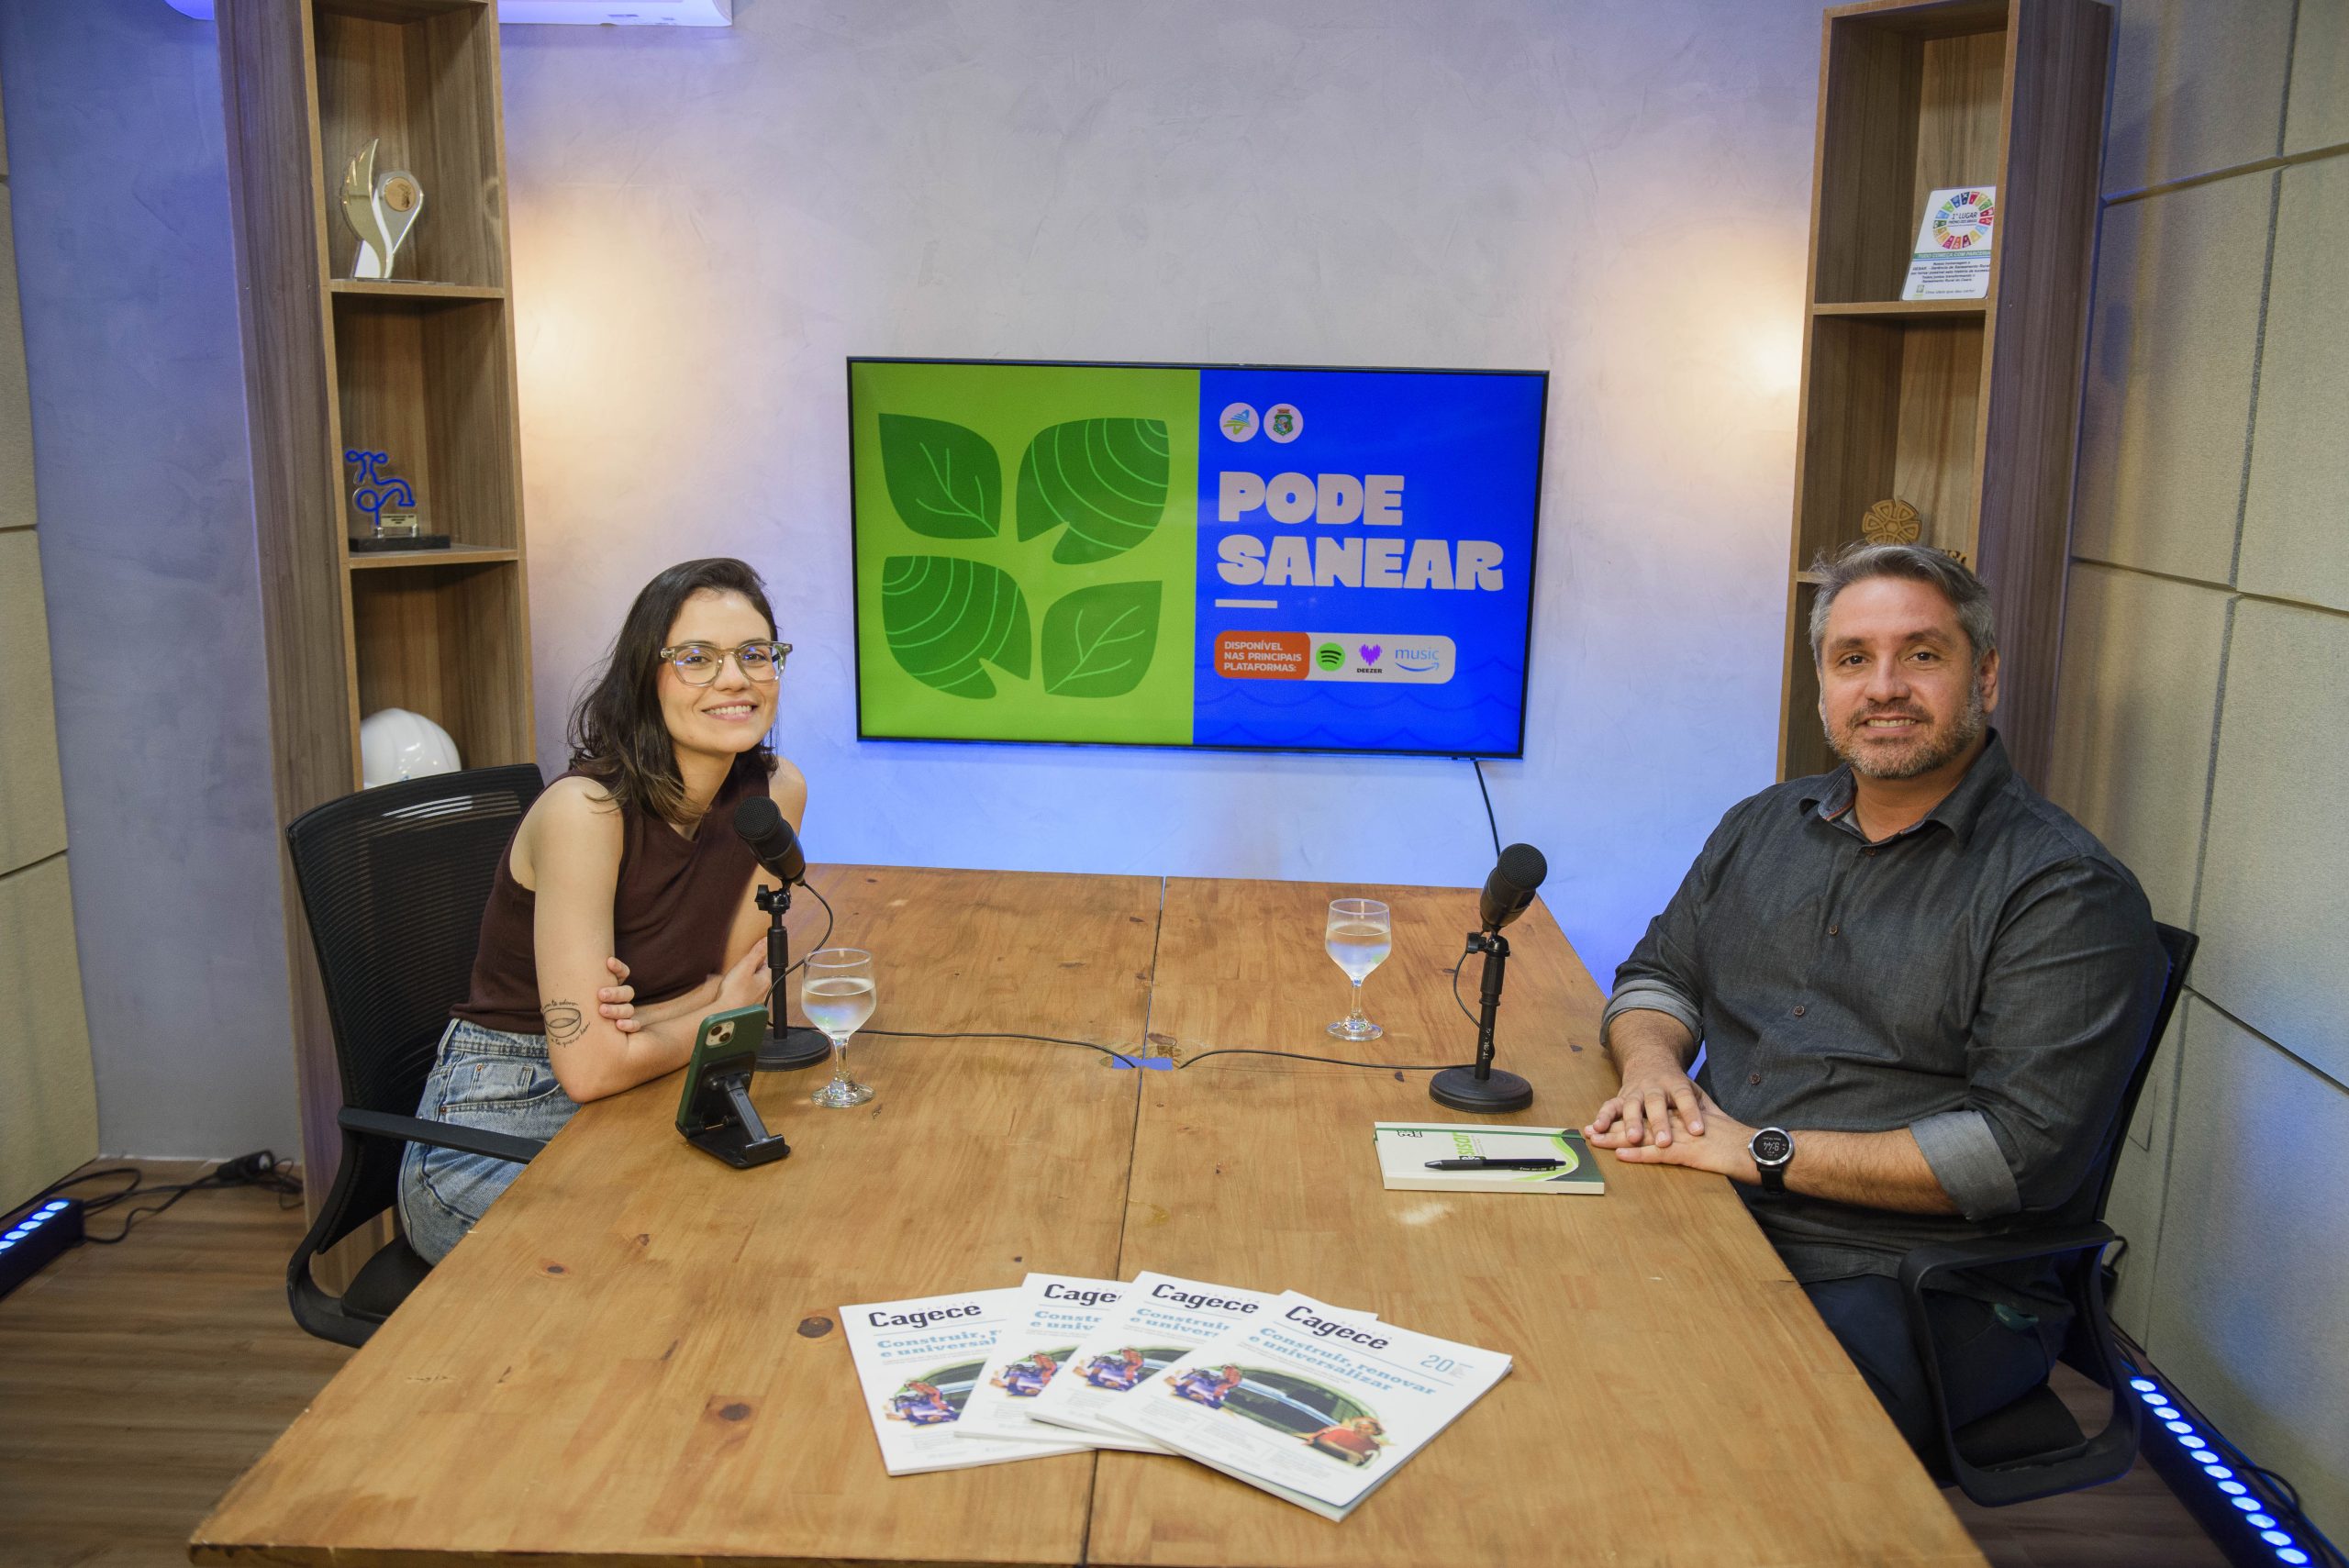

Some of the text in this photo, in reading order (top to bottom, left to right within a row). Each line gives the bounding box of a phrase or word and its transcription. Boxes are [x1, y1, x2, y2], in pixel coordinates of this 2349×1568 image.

[1959, 211, 1978, 219] LUGAR
[1219, 471, 1405, 526] PODE
[1217, 534, 1504, 591] SANEAR
[1224, 639, 1283, 651] DISPONÍVEL
[1224, 651, 1302, 662] NAS PRINCIPAIS
[1395, 647, 1440, 661] music
[1223, 662, 1297, 672] PLATAFORMAS:
[1044, 1284, 1121, 1307] Cage
[1152, 1284, 1259, 1313] Cagece
[868, 1305, 982, 1329] Cagece
[1285, 1306, 1388, 1350] Cagece
[877, 1330, 985, 1348] Construir,
[1260, 1328, 1352, 1367] Construir,
[1356, 1363, 1437, 1396] renovar
[1263, 1340, 1393, 1391] universalizar
[1419, 1354, 1454, 1372] 20
